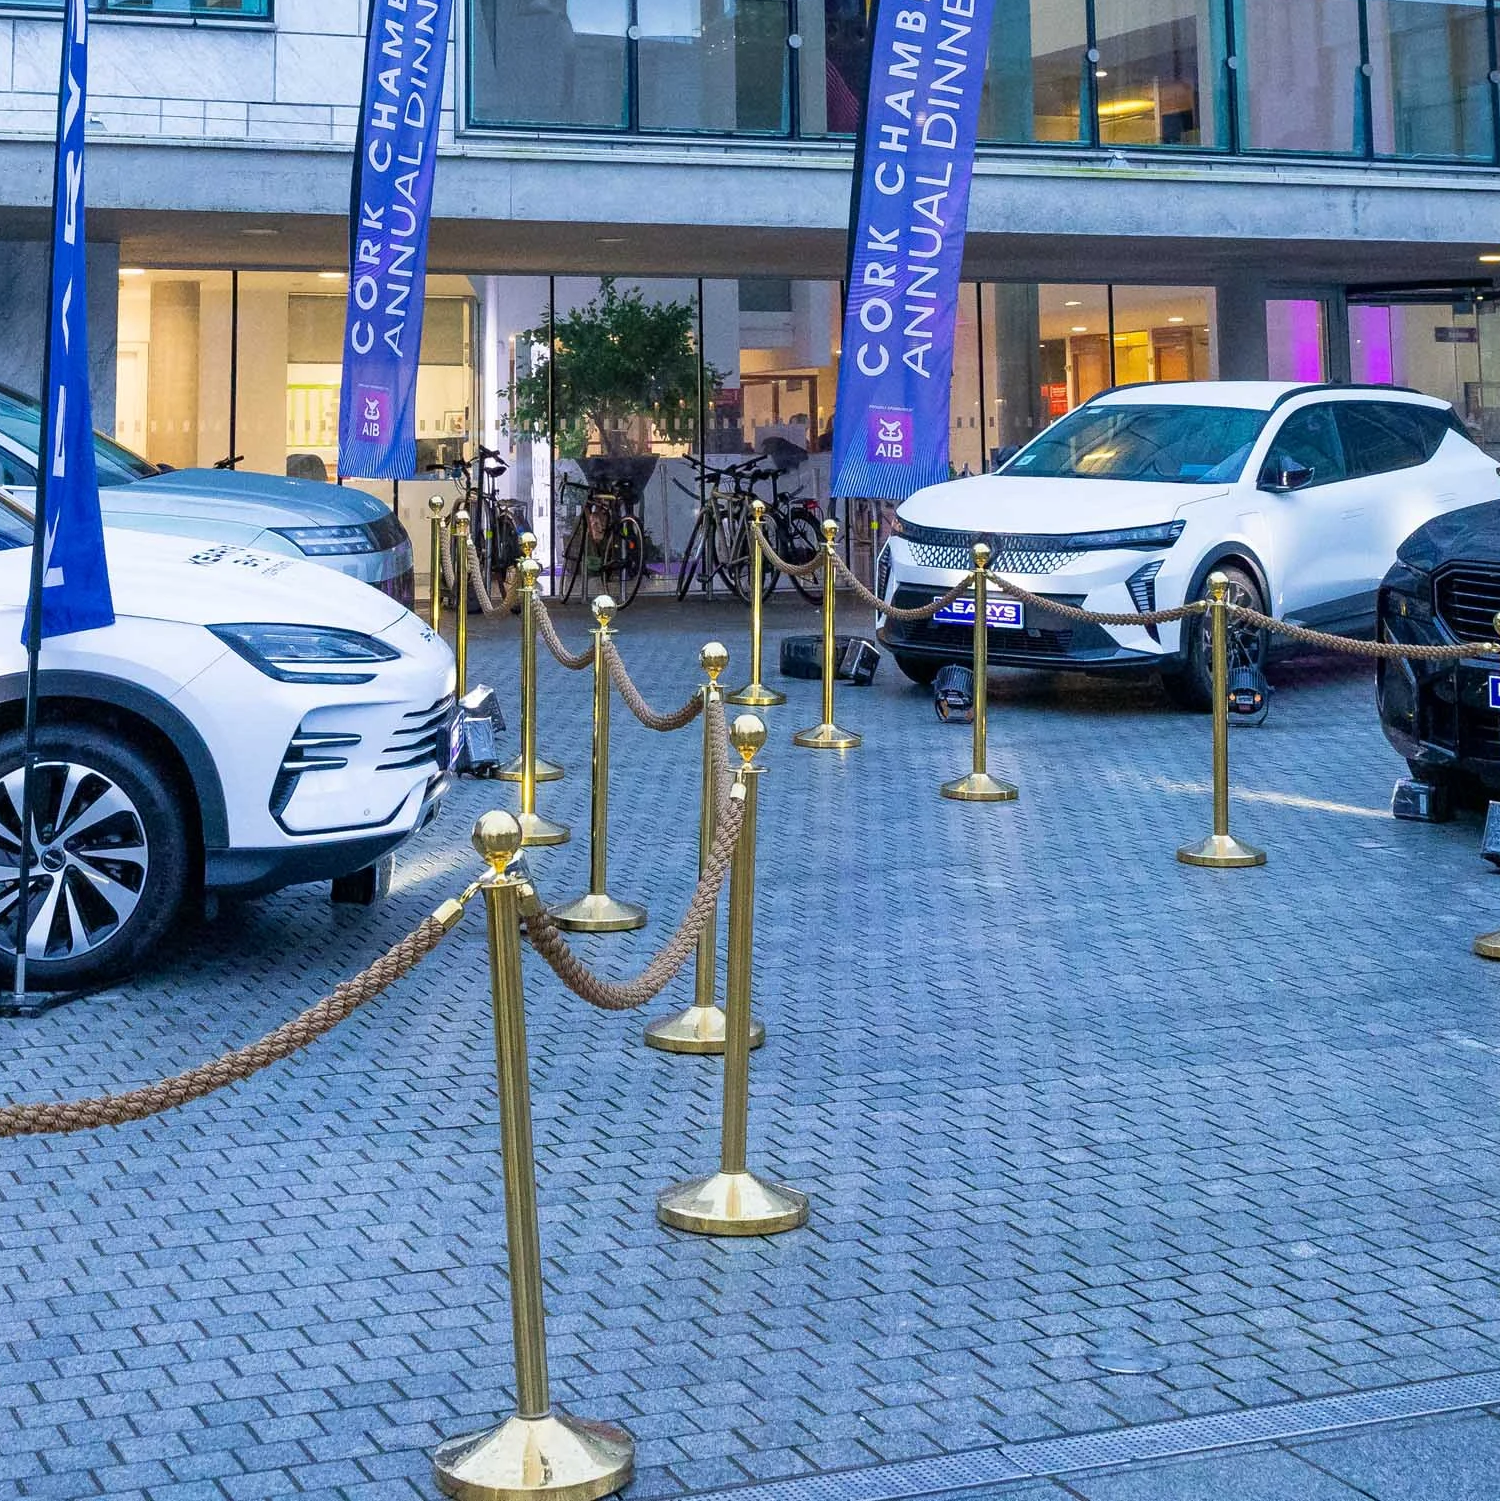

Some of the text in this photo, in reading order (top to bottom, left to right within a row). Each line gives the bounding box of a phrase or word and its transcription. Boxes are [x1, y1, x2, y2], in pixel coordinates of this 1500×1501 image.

[351, 200, 386, 355] CORK
[383, 142, 423, 357] ANNUAL
[856, 222, 901, 377] CORK
[902, 162, 953, 379] ANNUAL
[362, 422, 380, 437] AIB
[875, 443, 903, 458] AIB
